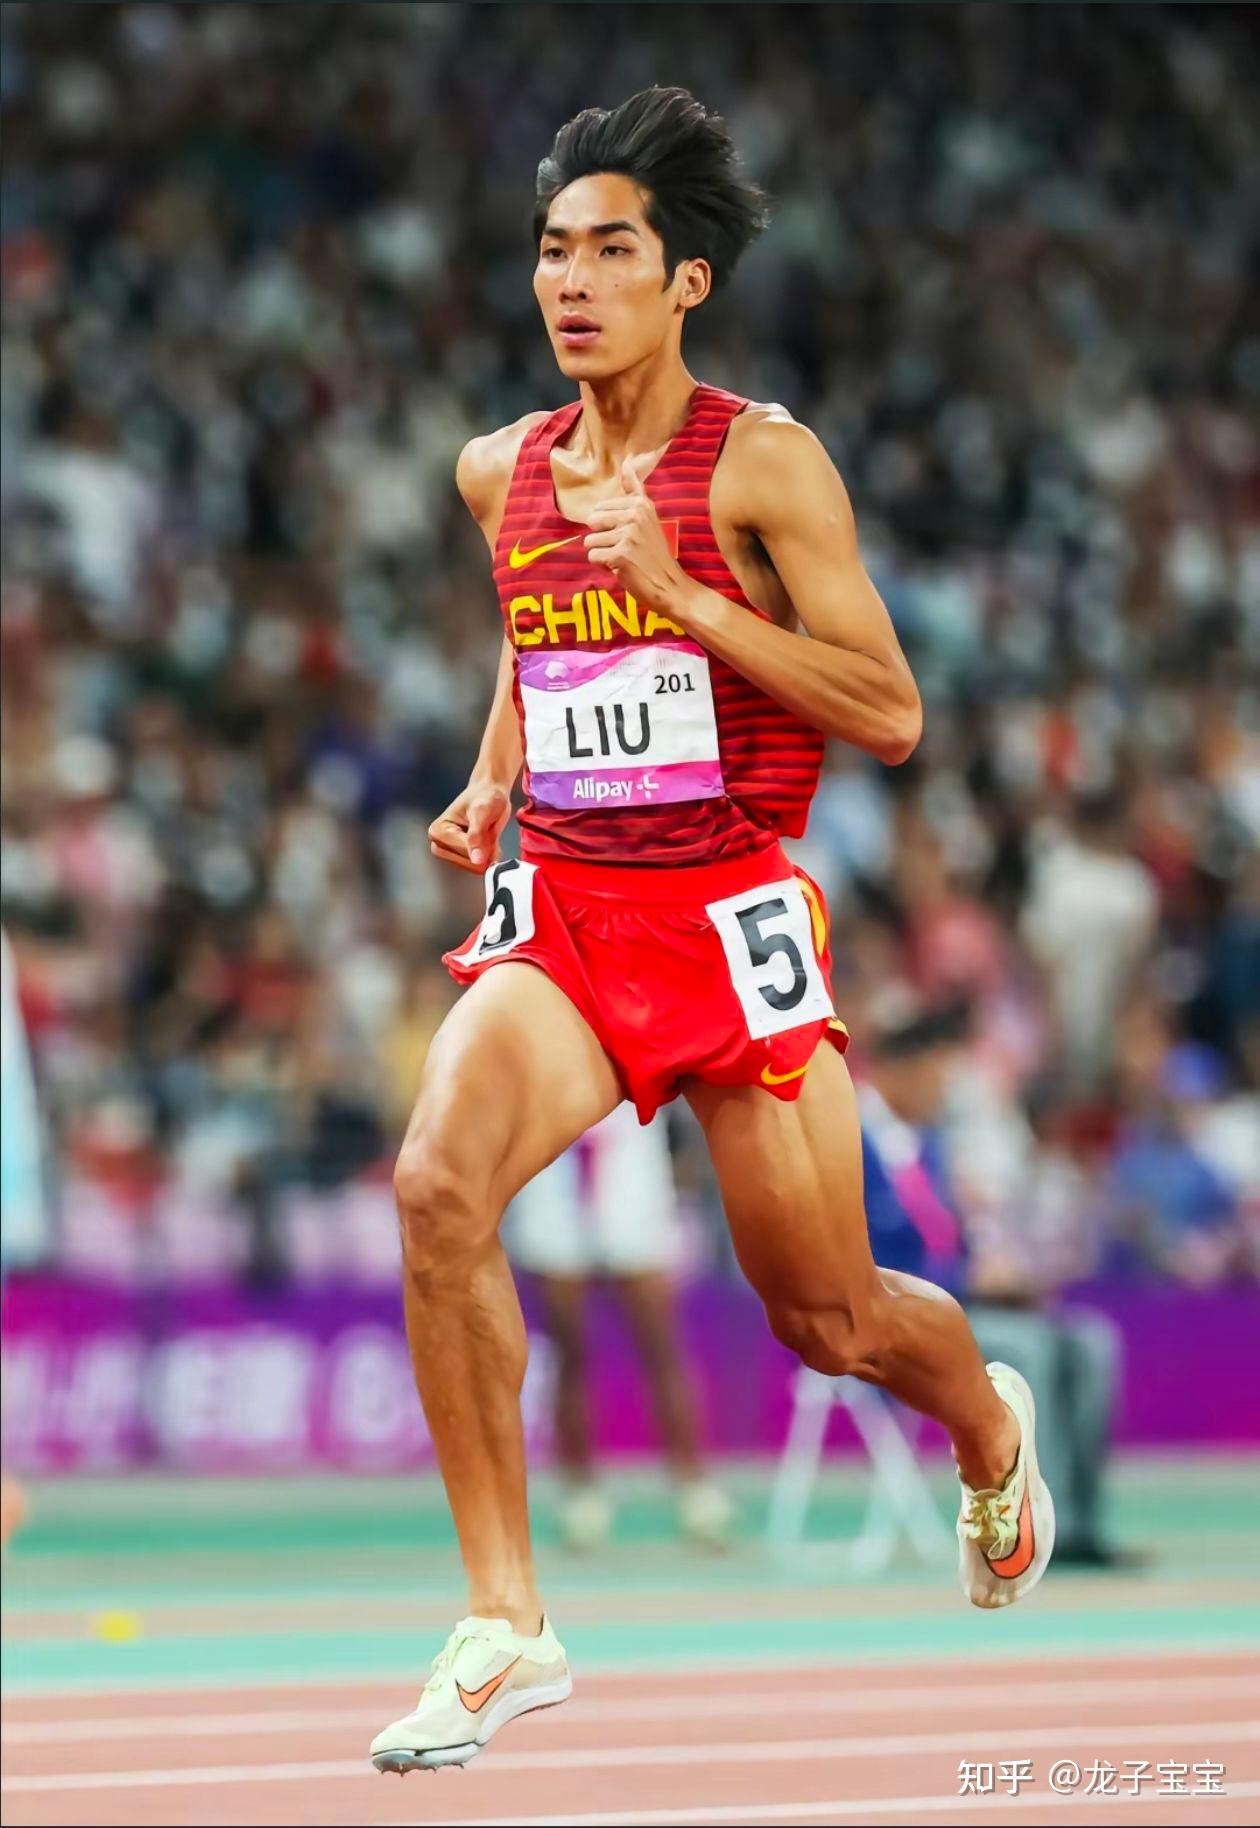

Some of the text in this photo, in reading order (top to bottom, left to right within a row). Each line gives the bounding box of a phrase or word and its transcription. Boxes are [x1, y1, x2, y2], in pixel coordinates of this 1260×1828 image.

[653, 673, 696, 694] 201
[565, 702, 651, 758] LIU
[573, 776, 633, 803] Alipay
[735, 897, 808, 1011] 5
